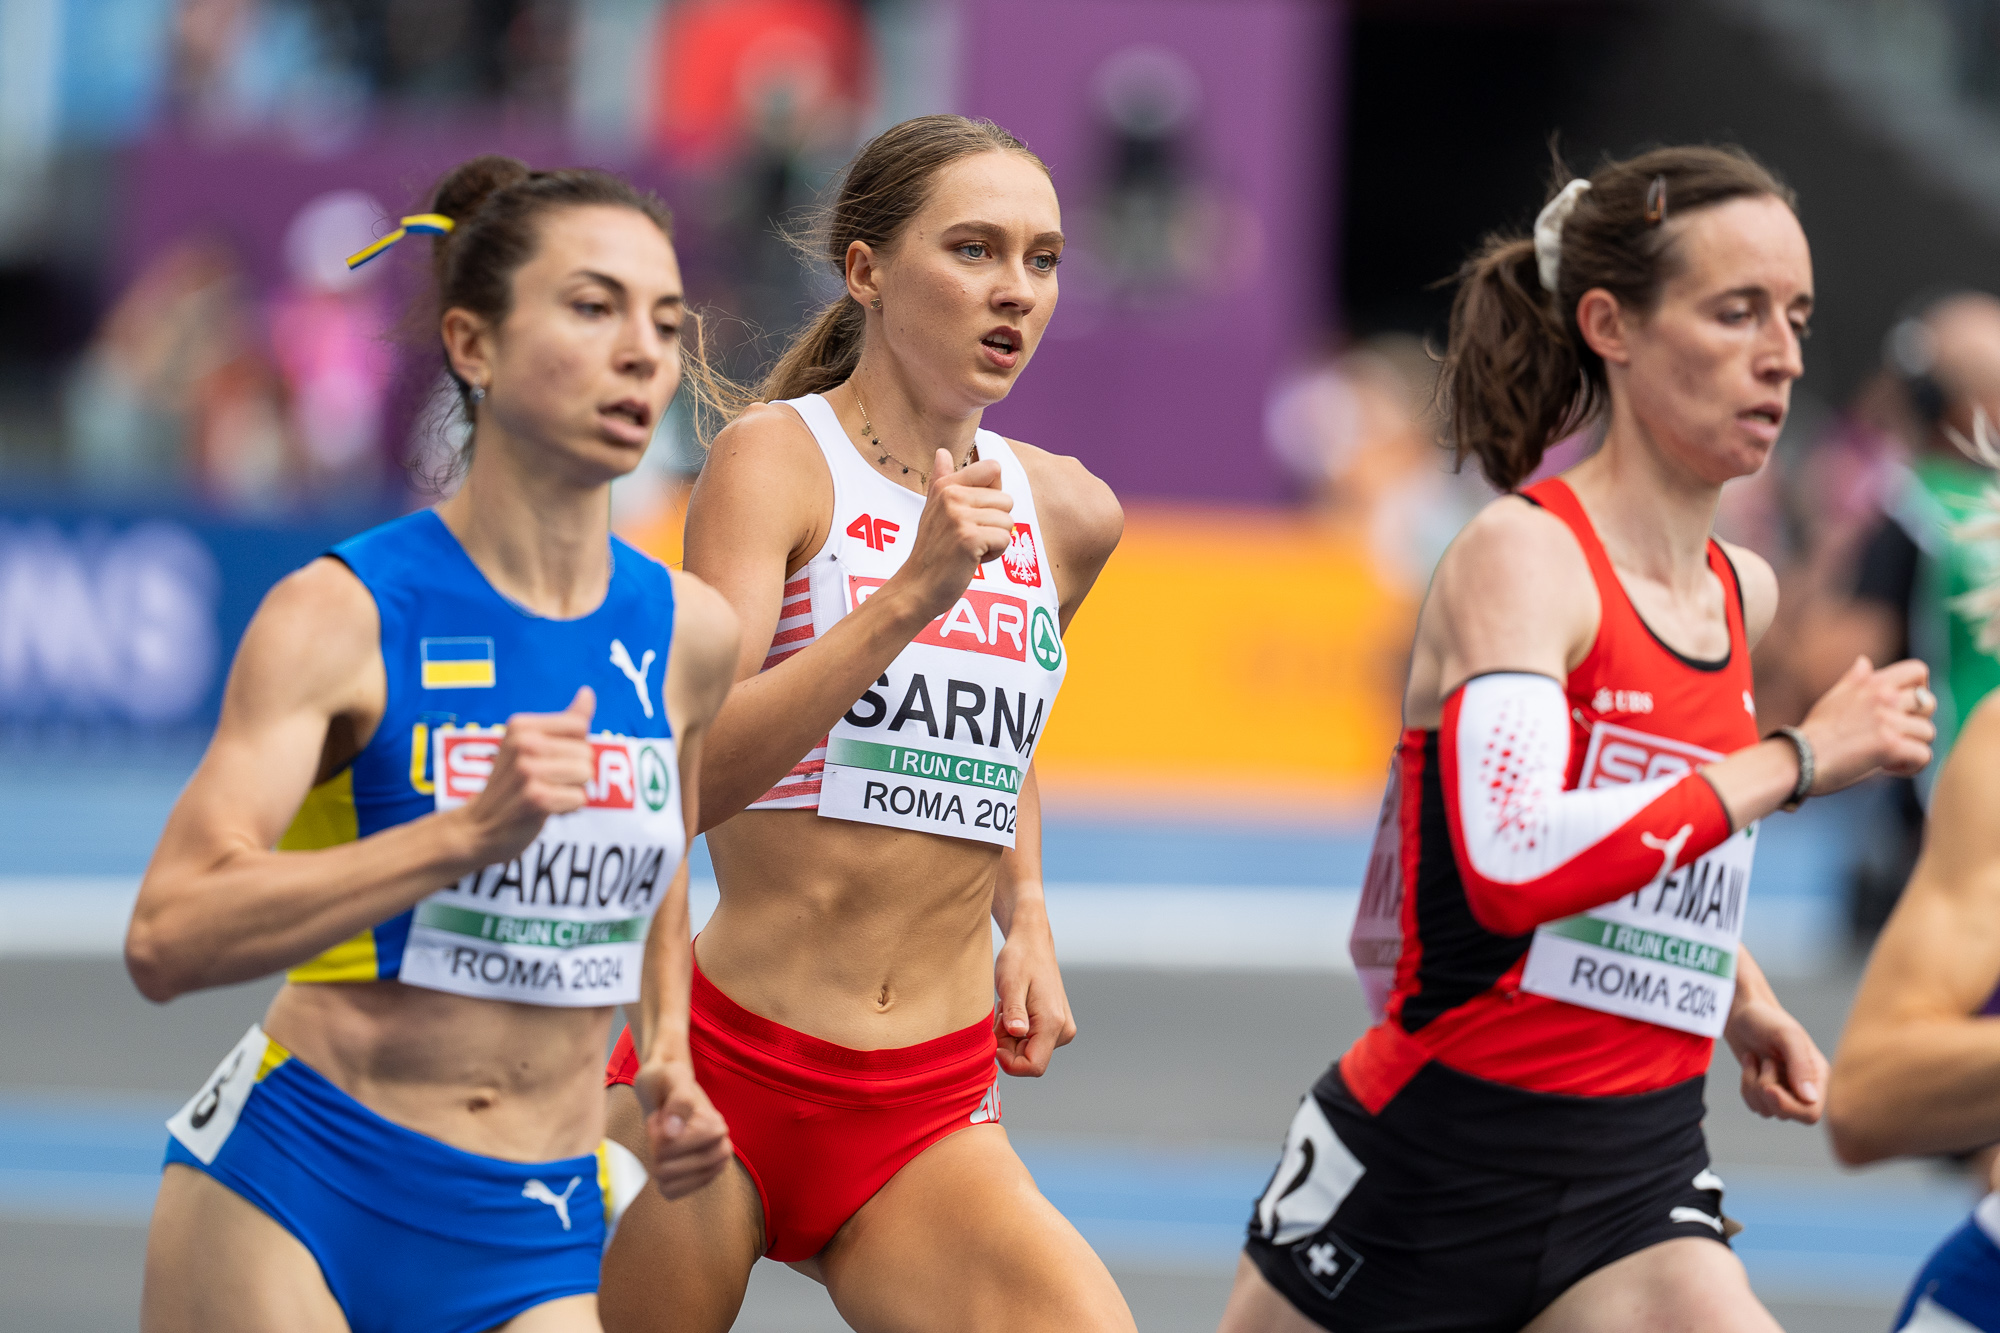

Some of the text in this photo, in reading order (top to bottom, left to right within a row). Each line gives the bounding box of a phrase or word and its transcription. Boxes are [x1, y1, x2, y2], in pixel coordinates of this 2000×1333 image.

[846, 513, 900, 552] 4F
[843, 672, 1044, 759] SARNA
[1615, 689, 1654, 714] UBS
[449, 741, 635, 804] SR
[889, 749, 1018, 790] I RUN CLEAN
[863, 780, 1017, 834] ROMA 202
[445, 842, 666, 907] AKHOVA
[481, 916, 495, 938] I
[495, 917, 549, 944] RUN
[1601, 923, 1614, 946] I
[1614, 926, 1664, 958] RUN
[452, 947, 623, 990] ROMA 2024
[1572, 955, 1717, 1018] ROMA 2024
